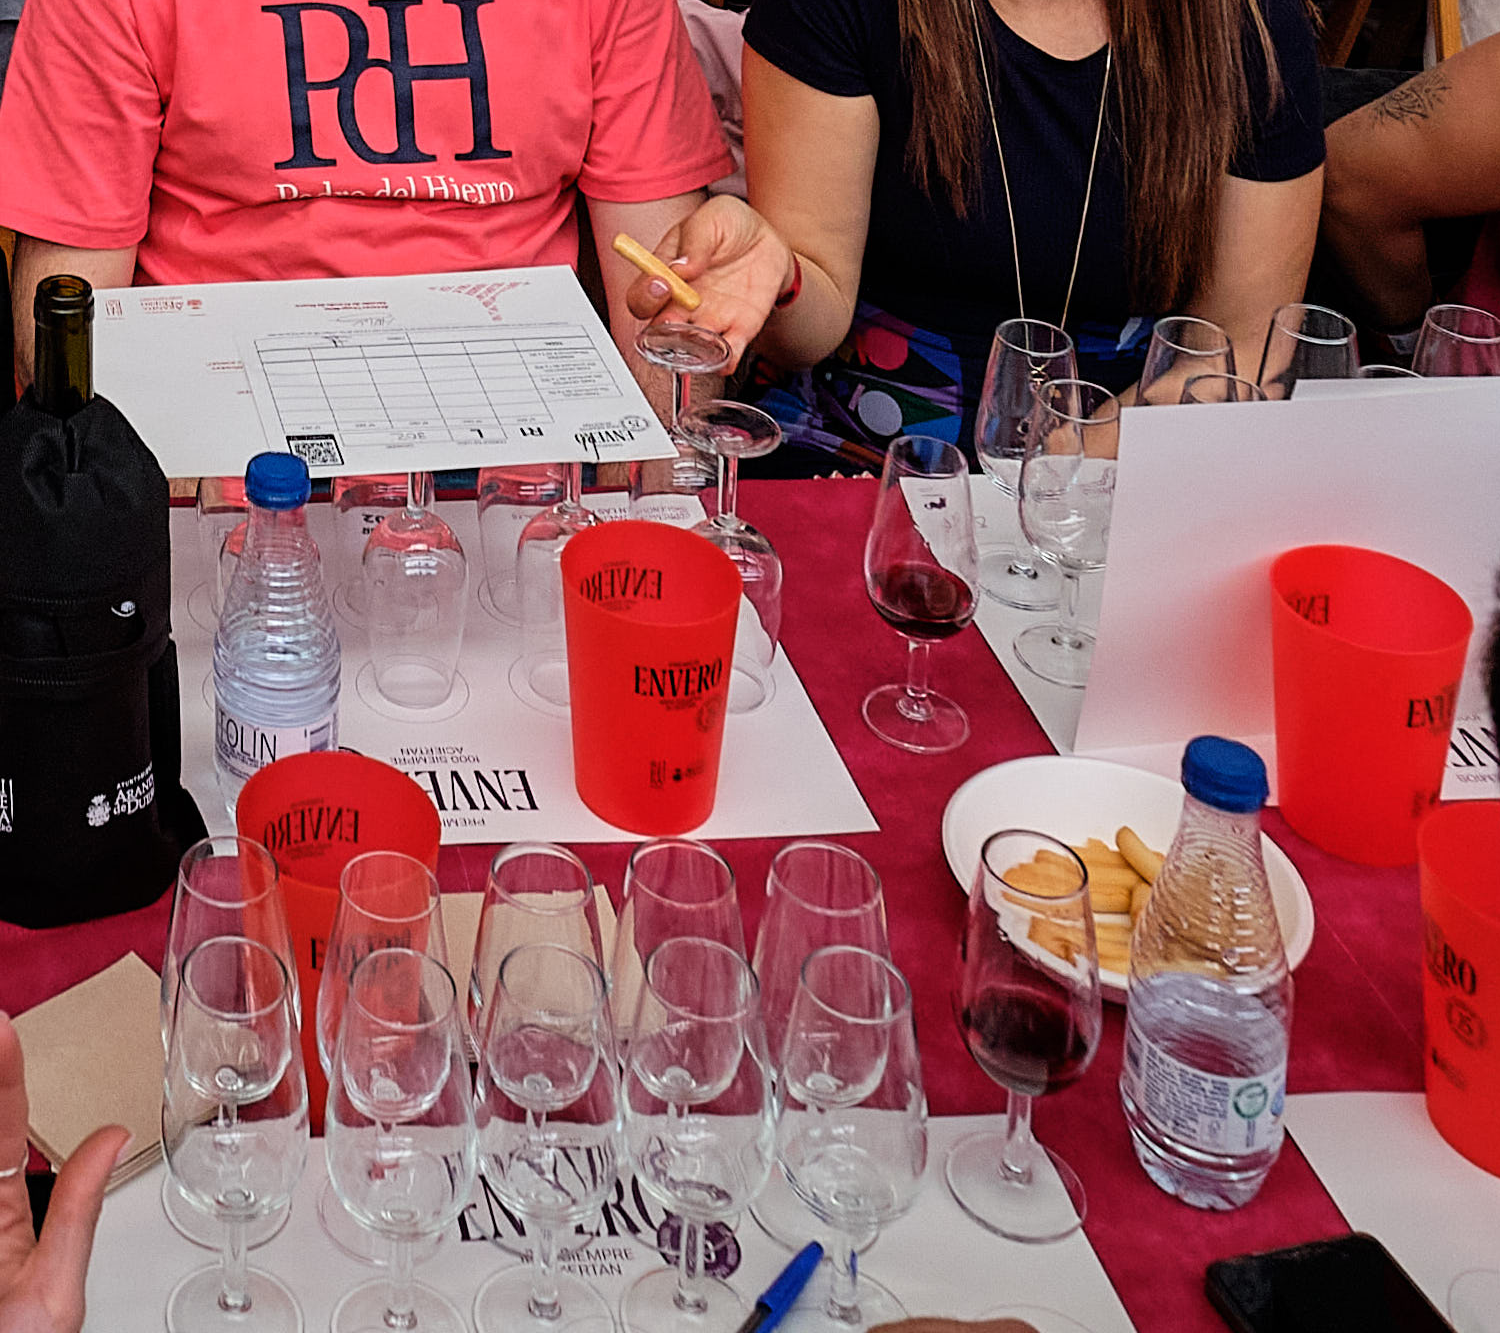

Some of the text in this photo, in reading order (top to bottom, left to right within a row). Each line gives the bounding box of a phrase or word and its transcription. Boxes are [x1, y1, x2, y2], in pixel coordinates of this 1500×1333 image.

[421, 174, 515, 206] Hierro
[469, 426, 545, 440] L R1
[634, 657, 722, 697] ENVERO
[400, 746, 464, 757] ACIERTAN
